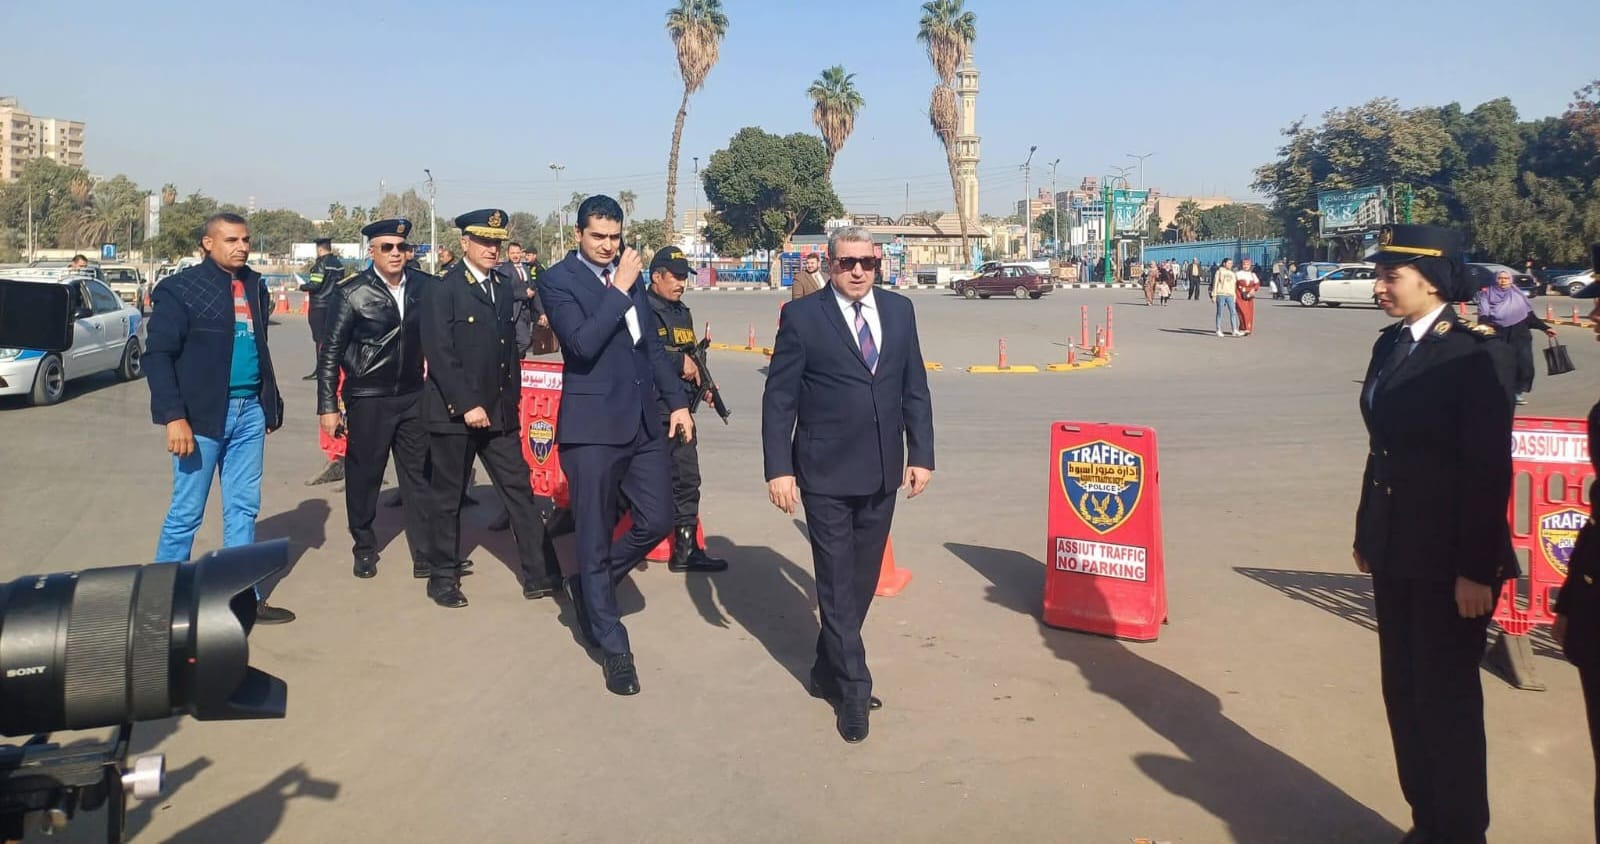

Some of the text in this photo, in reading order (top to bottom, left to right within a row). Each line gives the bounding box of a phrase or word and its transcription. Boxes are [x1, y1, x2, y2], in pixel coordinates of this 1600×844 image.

[1519, 434, 1568, 457] ASSIUT
[1072, 445, 1136, 466] TRAFFIC
[1095, 465, 1115, 476] مرور
[1088, 484, 1117, 492] POLICE
[1542, 512, 1589, 529] TRAFF
[1058, 539, 1144, 563] ASSIUT TRAFFIC
[1058, 556, 1144, 579] NO PARKING
[6, 666, 46, 677] SONY
